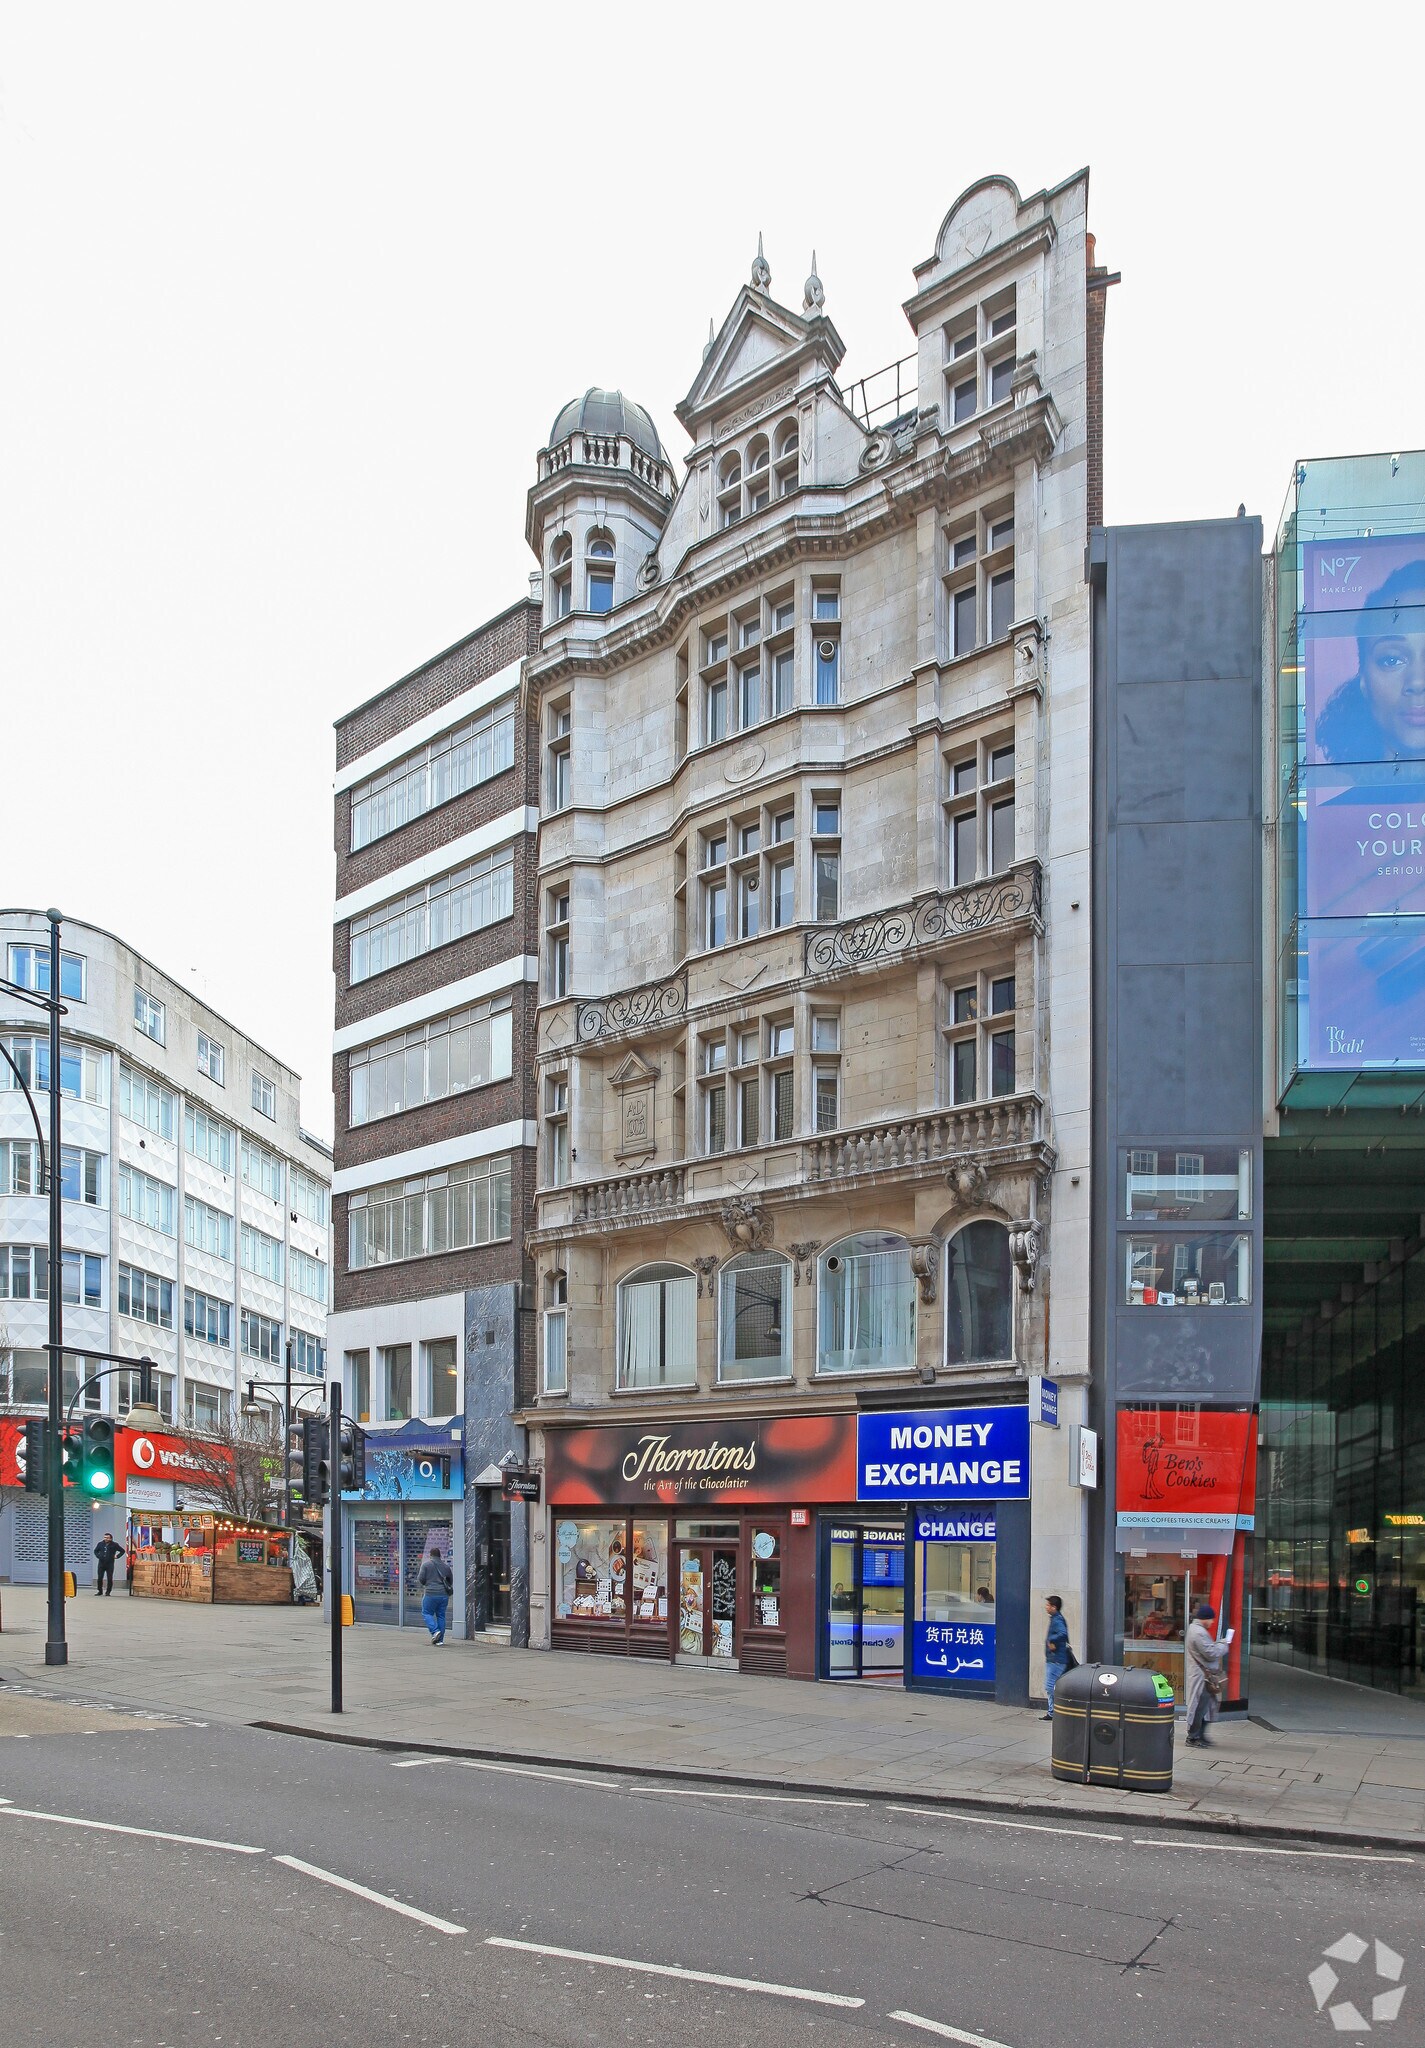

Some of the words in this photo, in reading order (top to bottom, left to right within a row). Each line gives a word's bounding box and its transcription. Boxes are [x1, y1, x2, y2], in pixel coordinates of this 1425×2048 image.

[1321, 586, 1363, 594] MAKE-UP
[1368, 811, 1425, 829] COL
[1356, 839, 1423, 856] YOUR
[1326, 1026, 1346, 1041] Ta
[1328, 1039, 1365, 1054] Dah!
[1041, 1387, 1057, 1402] MONEY
[1041, 1401, 1057, 1415] CHANGE
[891, 1423, 993, 1449] MONEY
[622, 1435, 756, 1482] Thorntons
[1163, 1453, 1204, 1471] Ben's
[865, 1460, 1021, 1486] EXCHANGE
[1165, 1470, 1218, 1488] Cookies
[643, 1478, 656, 1491] the
[657, 1480, 673, 1490] Art
[674, 1477, 685, 1495] of
[684, 1476, 698, 1490] the
[699, 1475, 749, 1490] Chocolatier
[919, 1522, 996, 1538] CHANGE
[150, 1563, 192, 1588] JUICEBOX
[152, 1587, 191, 1597] LONDON
[925, 1626, 984, 1646] 货币兑换
[925, 1648, 984, 1674] صرف
